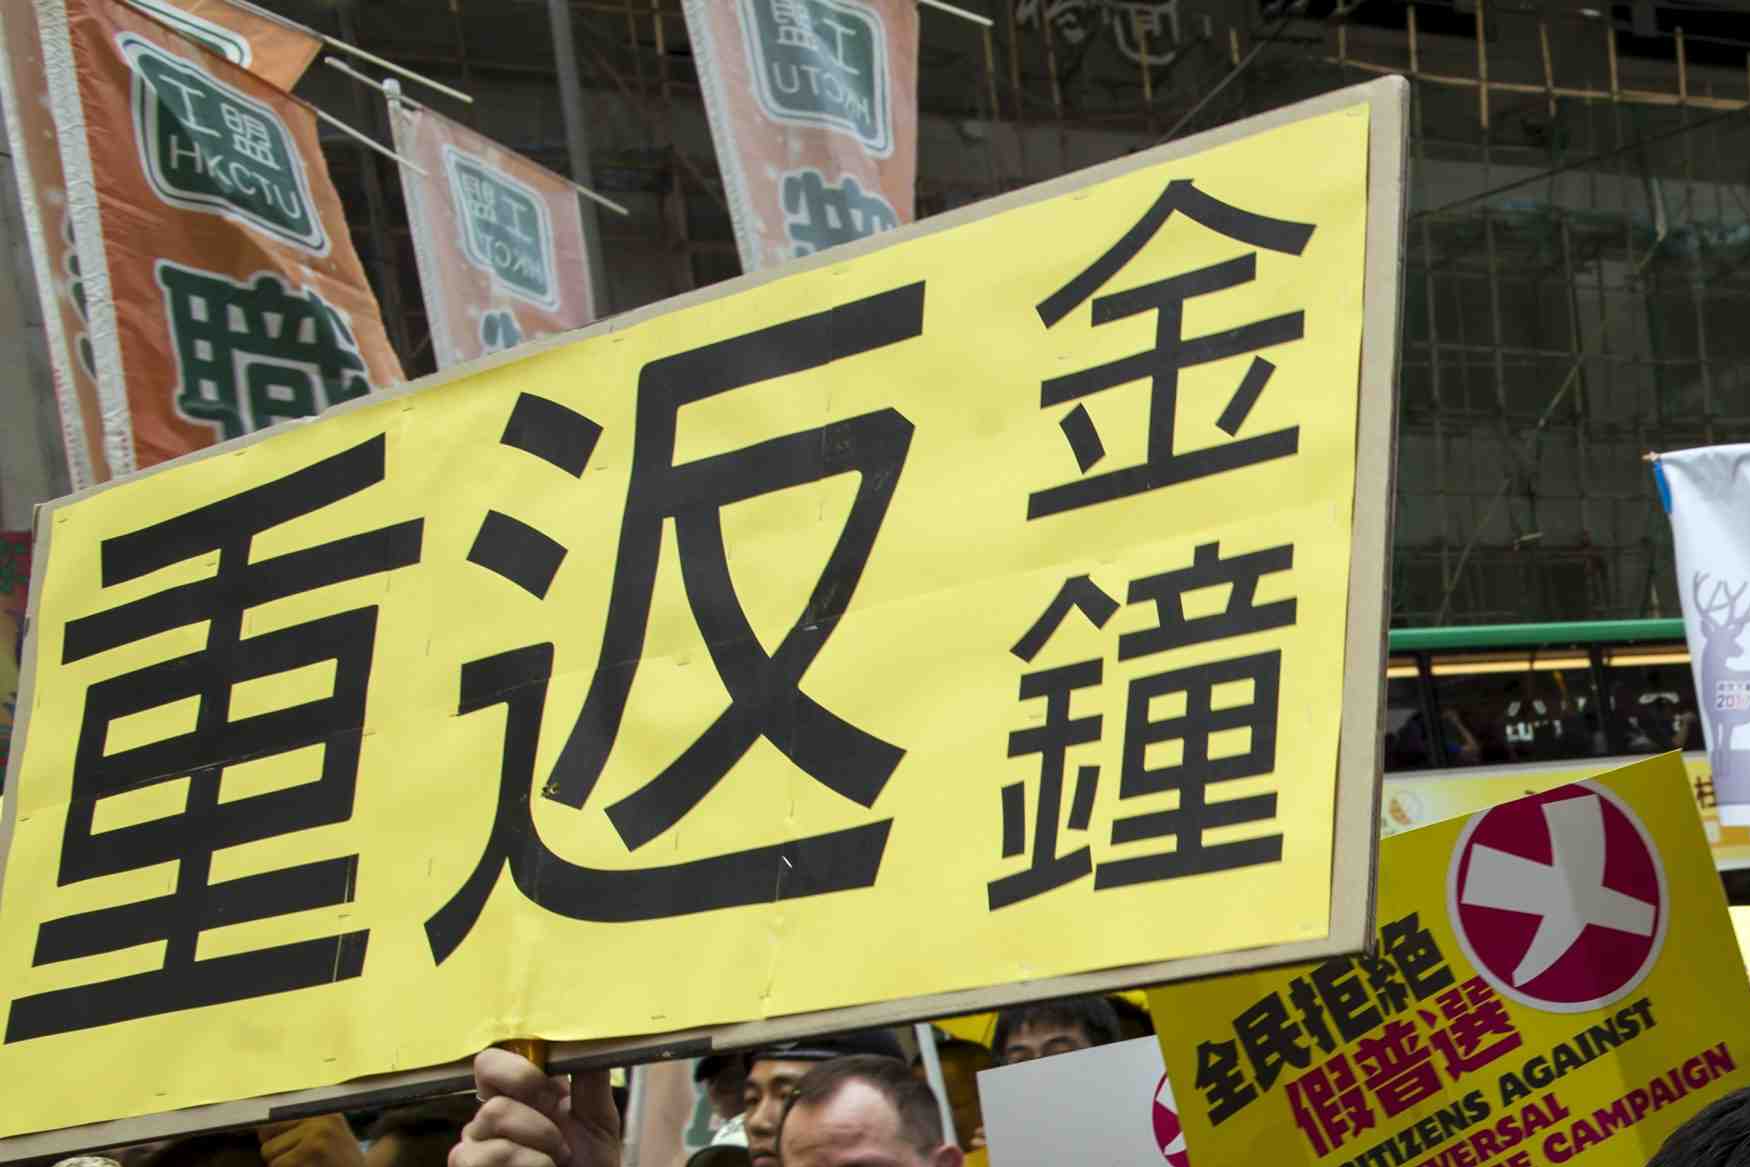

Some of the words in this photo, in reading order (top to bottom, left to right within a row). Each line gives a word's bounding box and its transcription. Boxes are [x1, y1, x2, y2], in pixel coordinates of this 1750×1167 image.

[159, 74, 281, 170] 工盟
[169, 135, 301, 219] HKCTU
[988, 178, 1317, 911] 金鐘
[5, 281, 926, 1044] 重返
[1284, 974, 1522, 1158] 假普選
[1501, 997, 1656, 1108] AGAINST
[1543, 1041, 1736, 1164] CAMPAIGN
